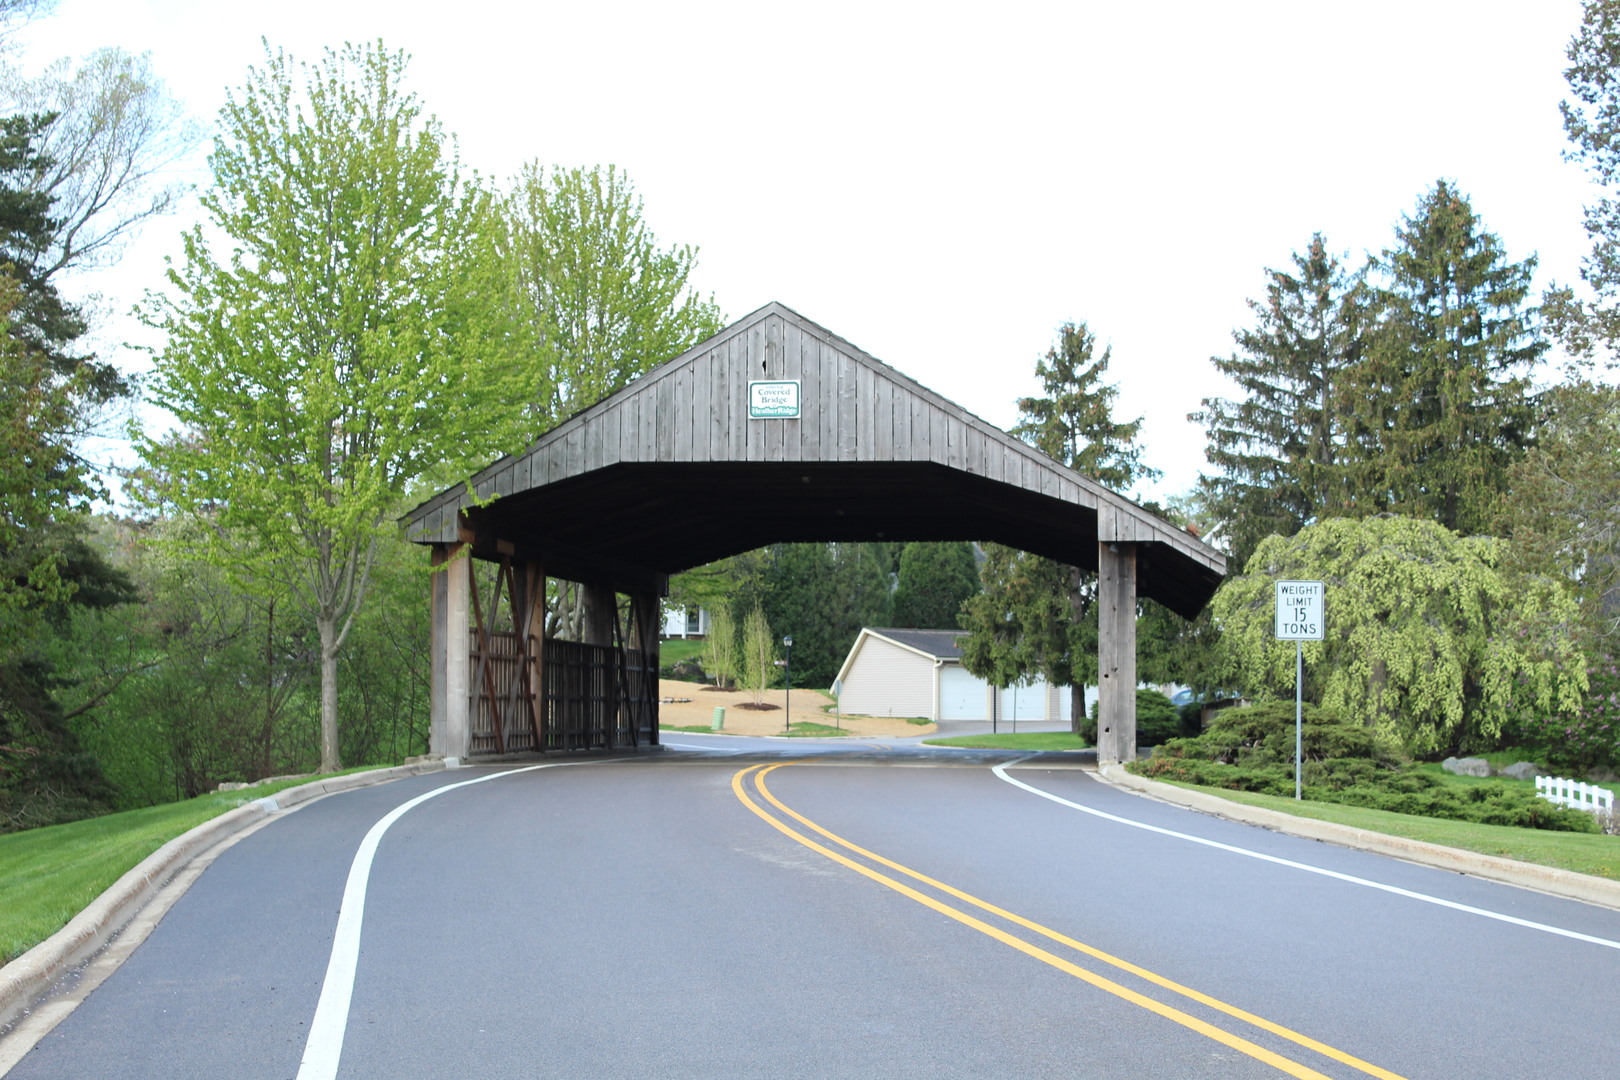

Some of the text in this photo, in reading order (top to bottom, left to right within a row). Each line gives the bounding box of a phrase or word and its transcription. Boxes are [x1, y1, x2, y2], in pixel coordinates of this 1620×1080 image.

[1281, 586, 1318, 594] WEIGHT
[1286, 597, 1312, 606] LIMIT
[1294, 607, 1307, 622] 15
[1282, 623, 1317, 635] TONS
